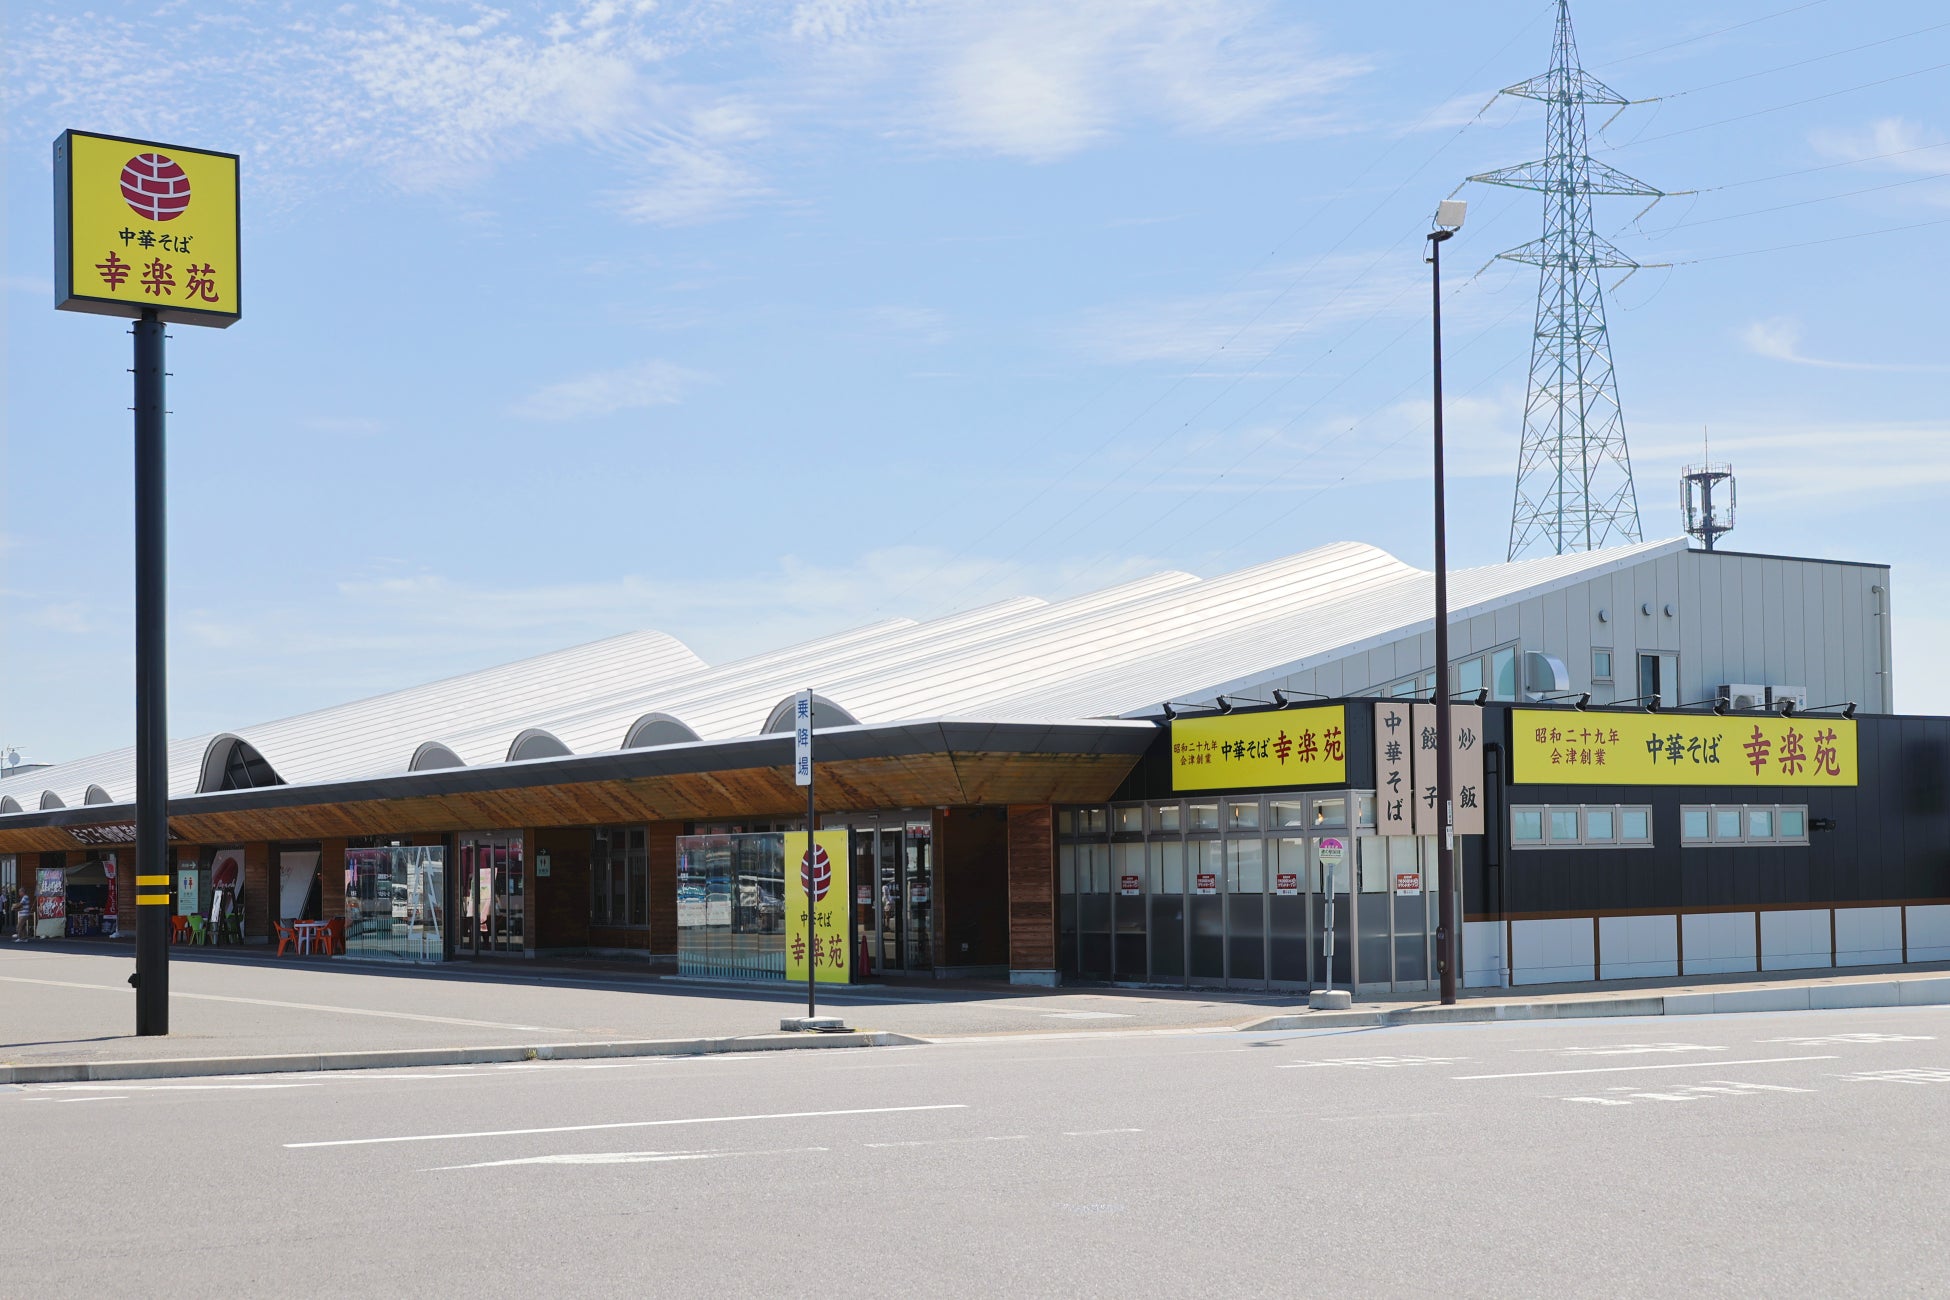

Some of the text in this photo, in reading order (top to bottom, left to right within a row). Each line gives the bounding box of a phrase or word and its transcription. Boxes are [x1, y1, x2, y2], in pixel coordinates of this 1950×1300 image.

[118, 227, 193, 254] 中華そば
[95, 251, 220, 303] 幸楽苑
[798, 699, 808, 775] 乗降場
[1174, 740, 1217, 753] 昭和二十九年
[1221, 726, 1344, 765] 中華そば 幸楽苑
[1535, 727, 1620, 746] 昭和二十九年
[1645, 724, 1841, 777] 中華そば 幸楽苑
[1180, 753, 1212, 766] 会津創業
[1384, 711, 1403, 821] 中華そば
[1421, 727, 1437, 809] 餃子
[1458, 728, 1478, 808] 炒飯
[1550, 748, 1606, 765] 会津創業
[800, 910, 832, 927] 中そば
